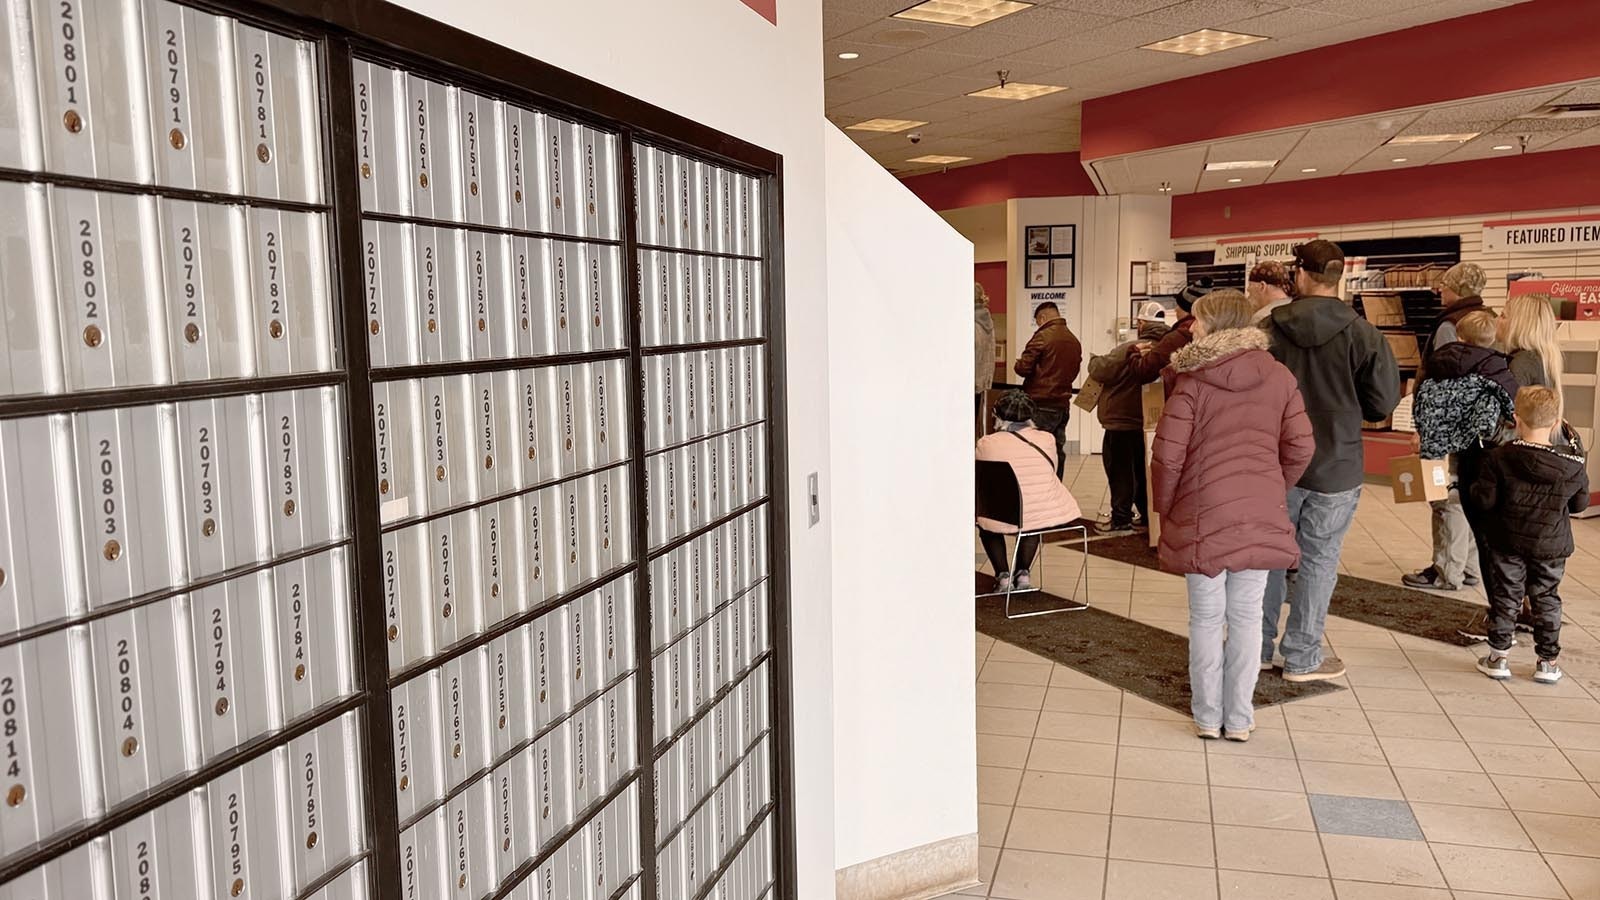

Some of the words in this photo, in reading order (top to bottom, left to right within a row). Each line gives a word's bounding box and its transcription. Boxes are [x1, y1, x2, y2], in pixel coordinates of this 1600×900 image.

[60, 1, 78, 104] 20801
[166, 29, 182, 123] 20791
[253, 53, 268, 139] 20781
[359, 83, 369, 158] 20771
[418, 99, 426, 169] 20761
[468, 112, 476, 177] 20751
[79, 220, 98, 318] 20802
[1225, 244, 1261, 259] SHIPPING
[1264, 241, 1304, 257] SUPPLI
[1506, 227, 1565, 245] FEATURED
[181, 227, 197, 317] 20792
[266, 232, 280, 314] 20782
[367, 241, 377, 315] 20772
[426, 247, 435, 315] 20762
[476, 251, 484, 314] 20752
[519, 254, 527, 314] 20742
[1031, 292, 1066, 300] WELCOME
[1551, 282, 1582, 296] Gifting
[377, 403, 388, 474] 20773
[434, 395, 444, 461] 20763
[483, 389, 492, 451] 20753
[526, 384, 534, 442] 20743
[564, 380, 572, 435] 20733
[99, 439, 117, 534] 20803
[199, 427, 213, 514] 20793
[281, 416, 293, 495] 20783
[441, 535, 450, 598] 20764
[490, 518, 498, 578] 20754
[532, 506, 540, 562] 20744
[386, 551, 396, 619] 20774
[212, 608, 226, 692] 20794
[292, 583, 304, 660] 20784
[117, 639, 134, 731] 20804
[452, 677, 460, 741] 20765
[497, 653, 505, 712] 20755
[1, 677, 20, 778] 20814
[397, 705, 408, 772] 20775
[305, 753, 316, 828] 20785
[502, 777, 510, 835] 20756
[228, 794, 242, 875] 20795
[457, 809, 466, 871] 20766
[136, 841, 151, 900] 208
[406, 846, 414, 900] 2077
